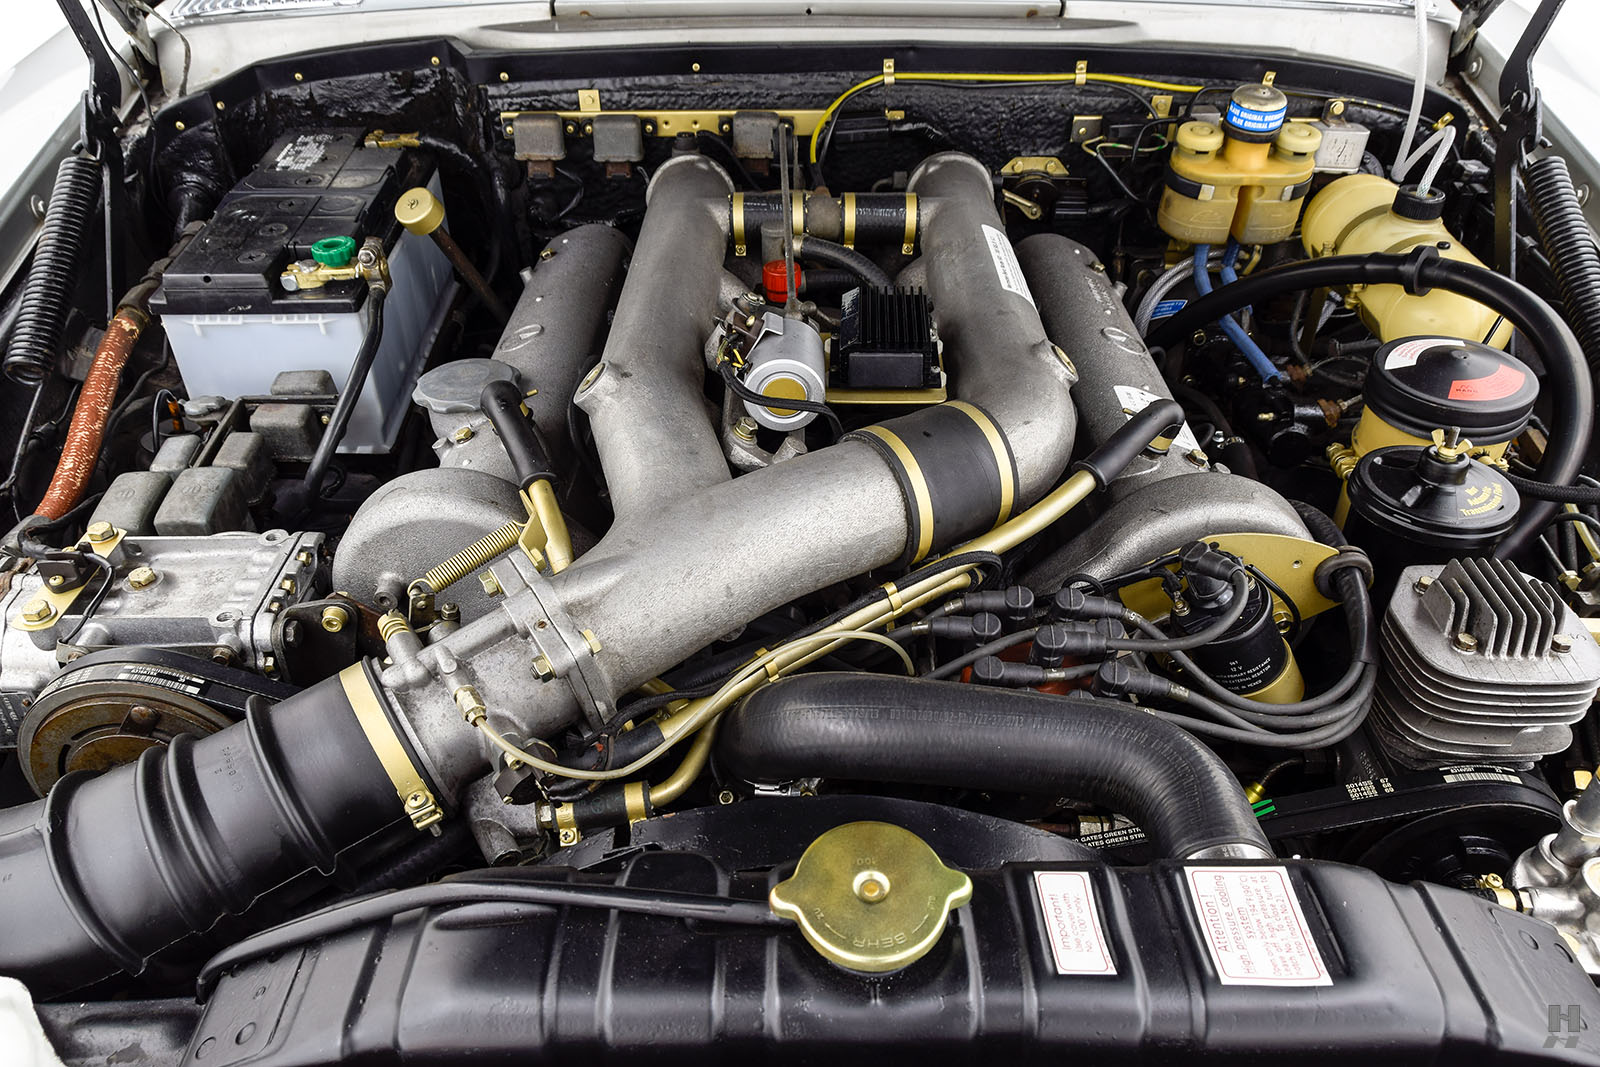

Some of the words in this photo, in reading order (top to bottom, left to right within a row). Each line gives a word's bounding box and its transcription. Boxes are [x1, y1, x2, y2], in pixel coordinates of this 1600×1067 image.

[1240, 112, 1263, 122] ORIGINAL
[1244, 120, 1268, 128] ORIGINAL
[1460, 495, 1502, 516] Transmission
[1247, 657, 1271, 674] RESISTANCE
[1252, 664, 1271, 678] RESISTOR
[1247, 680, 1262, 688] MEXICO
[1080, 833, 1103, 842] GATES
[1103, 830, 1127, 838] GREEN
[1105, 836, 1129, 844] GREEN
[1214, 875, 1229, 908] cooling
[1264, 885, 1273, 900] turn
[1063, 893, 1072, 910] with
[1255, 888, 1272, 919] pressure
[1271, 904, 1281, 921] close
[1048, 893, 1072, 950] Important!
[1067, 912, 1078, 936] cover
[1205, 901, 1230, 952] Attention
[1237, 906, 1256, 939] system
[1225, 911, 1247, 950] pressure
[852, 931, 908, 949] BEHR
[1294, 941, 1306, 957] stop
[1240, 954, 1253, 974] High
